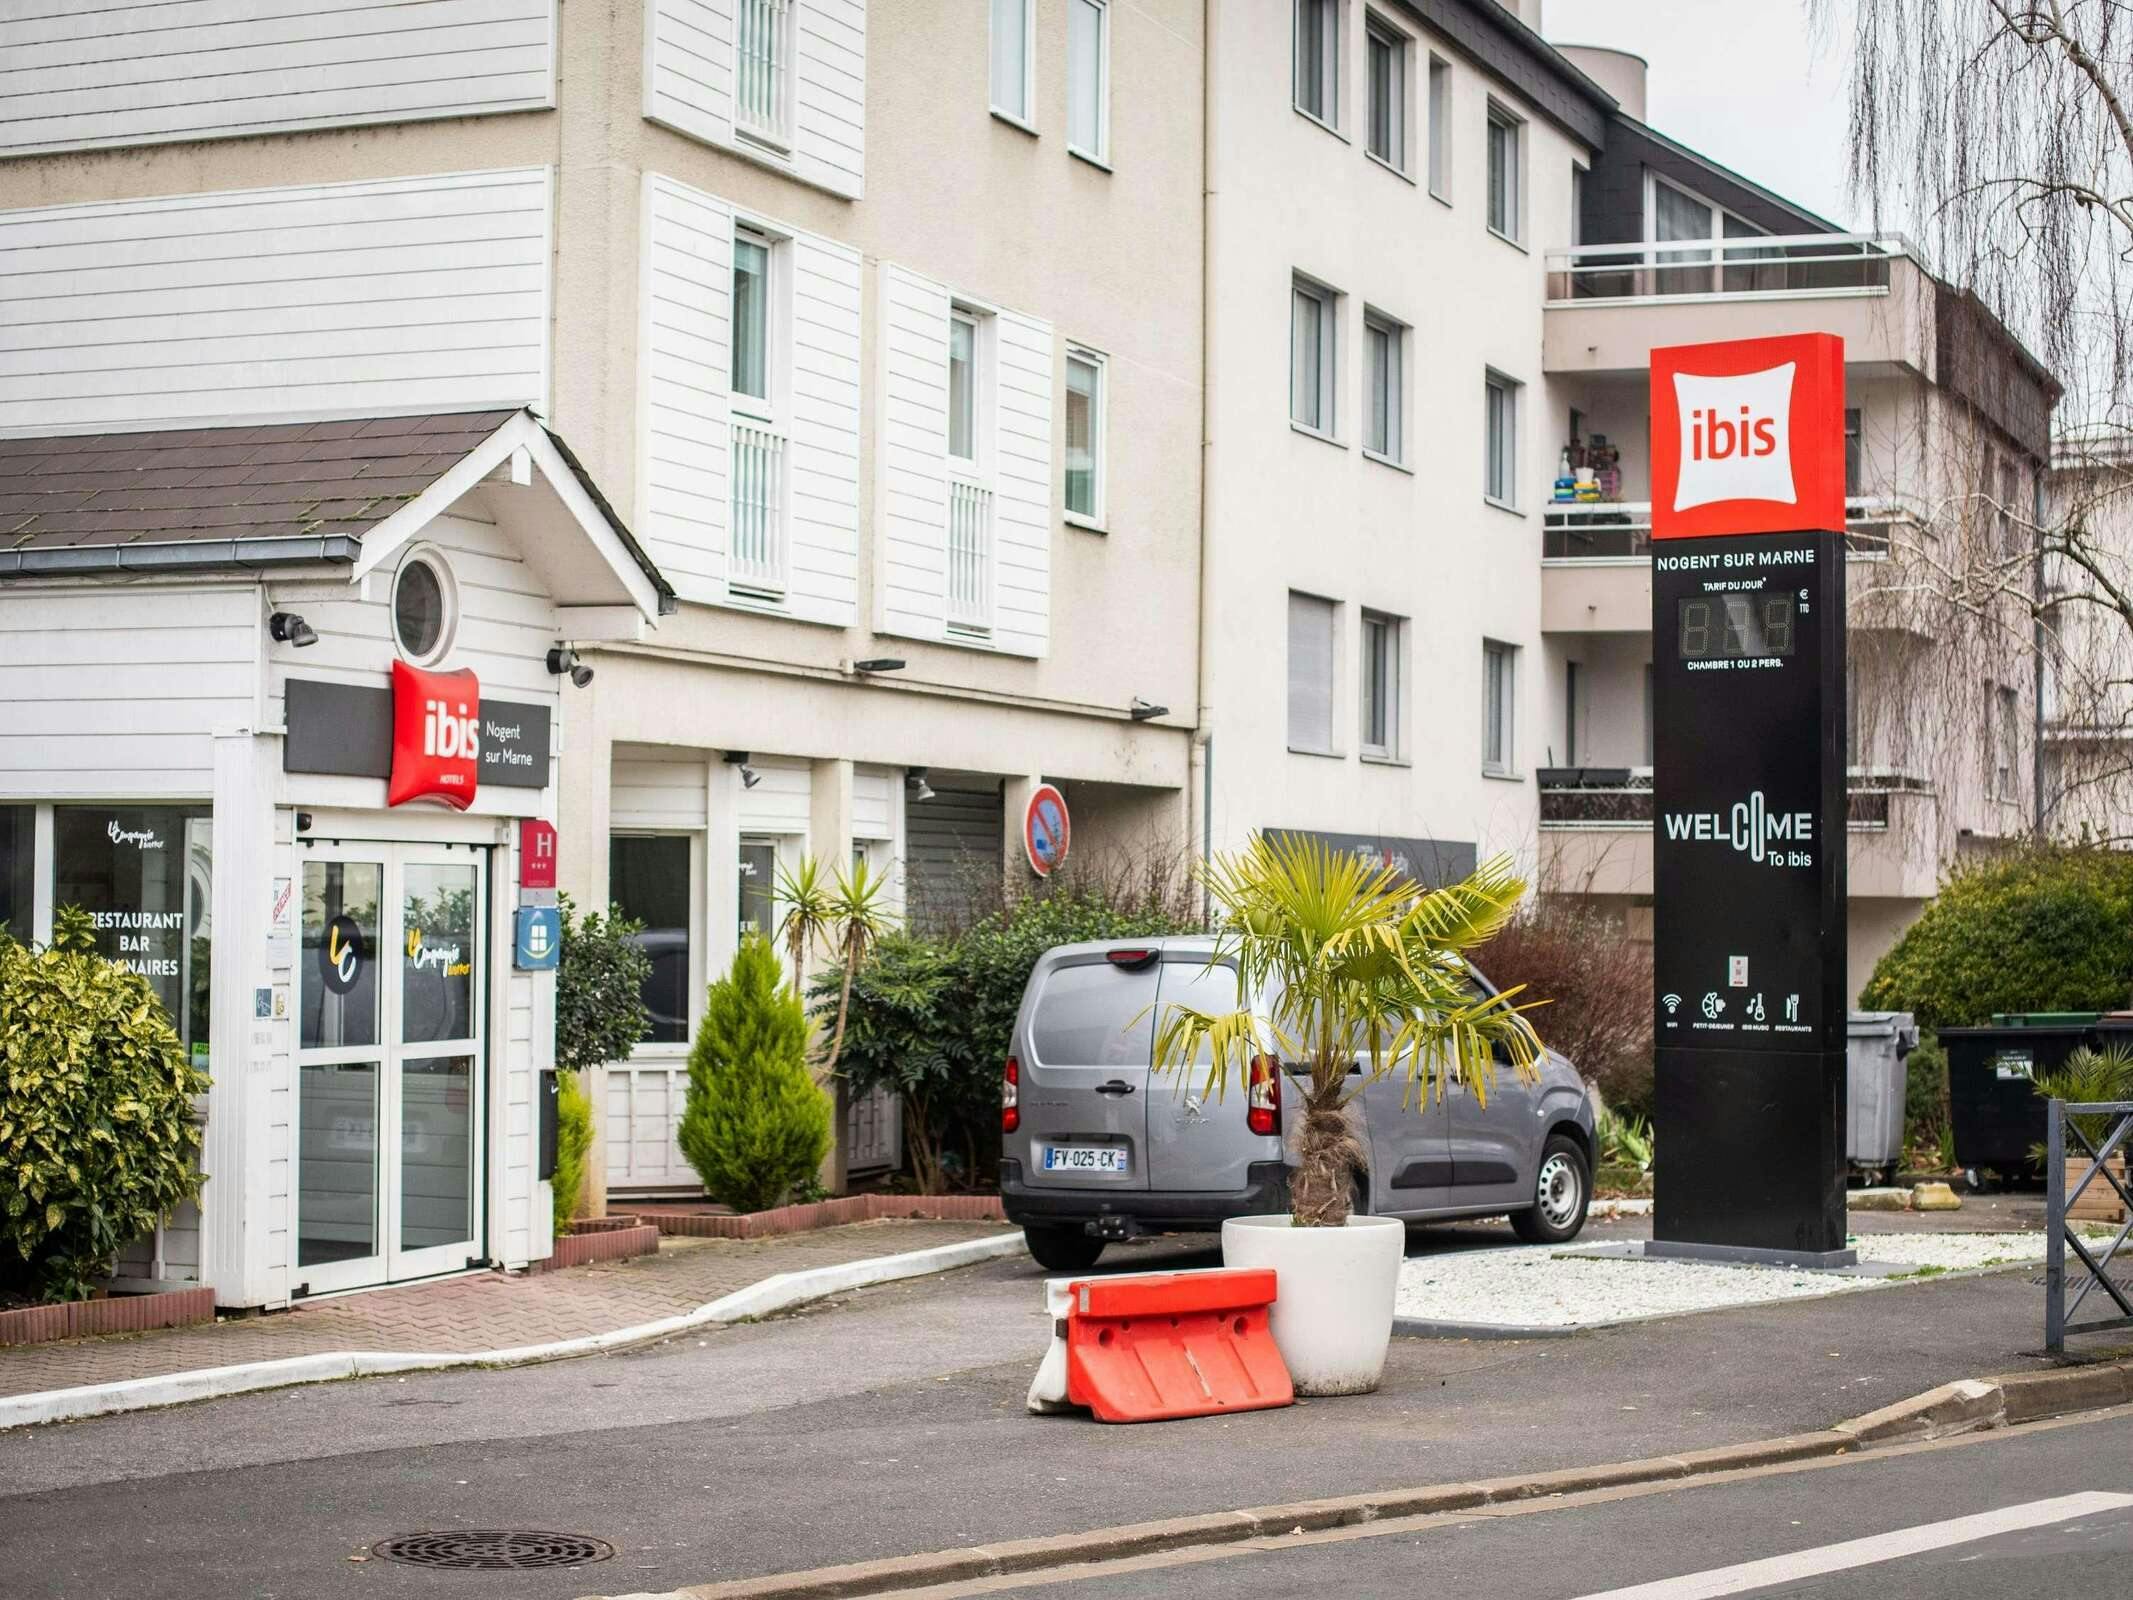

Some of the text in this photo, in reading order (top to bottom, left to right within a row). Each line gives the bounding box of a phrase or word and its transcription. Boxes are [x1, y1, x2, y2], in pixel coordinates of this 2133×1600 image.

[1692, 405, 1776, 461] ibis
[1657, 549, 1815, 571] NOGENT SUR MARNE
[1703, 581, 1727, 591] TARIF
[1728, 581, 1740, 590] DU
[1688, 661, 1729, 671] CHAMBRE
[1730, 661, 1735, 669] 1
[1737, 661, 1750, 669] OU
[1751, 660, 1757, 669] 2
[424, 699, 480, 760] ibis
[485, 721, 521, 742] Nogent
[485, 748, 533, 766] sur Marne
[1665, 791, 1813, 863] WELCOME
[536, 832, 552, 857] H
[1767, 851, 1812, 867] To ibis
[119, 935, 150, 952] BAR
[107, 959, 178, 976] NAIRES
